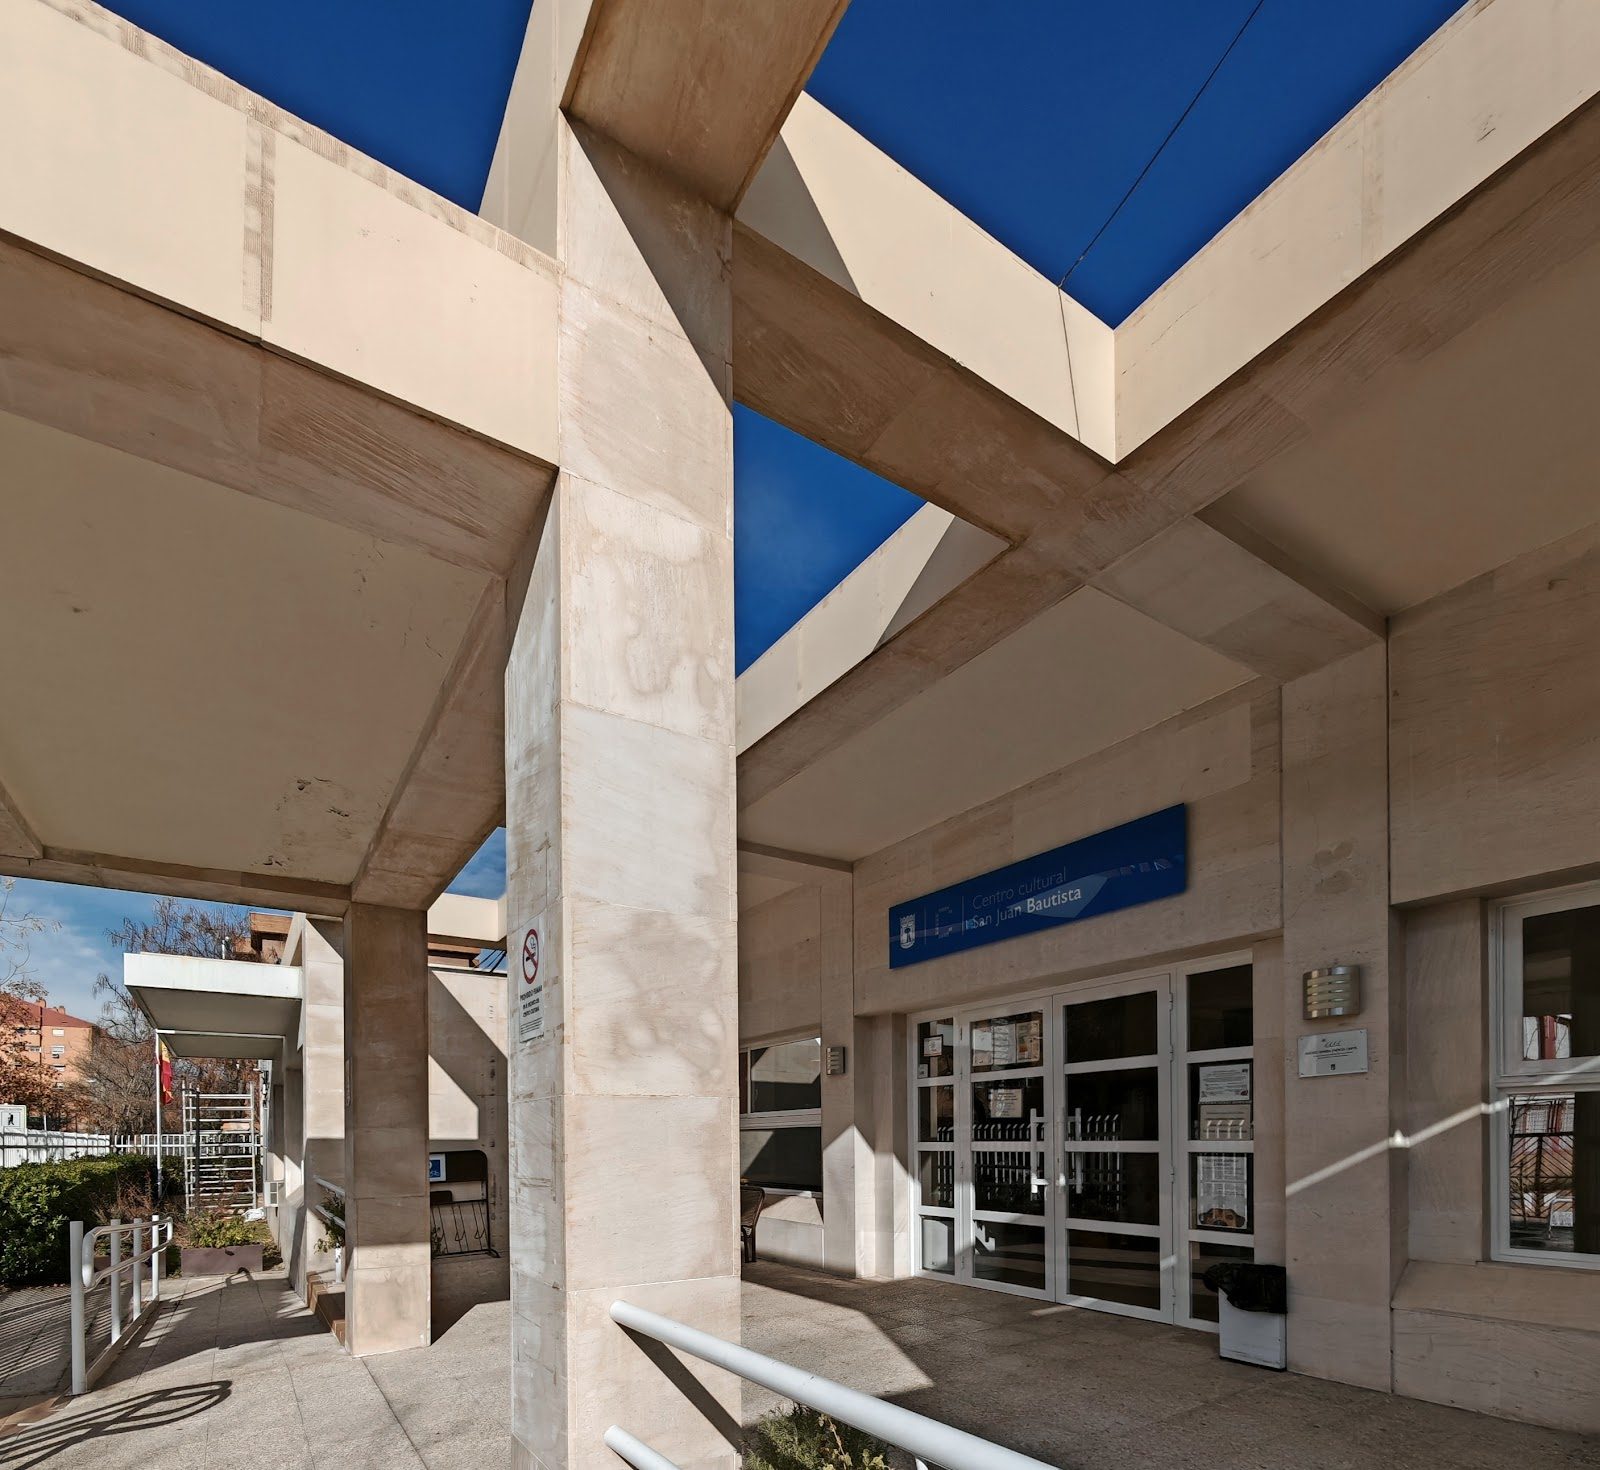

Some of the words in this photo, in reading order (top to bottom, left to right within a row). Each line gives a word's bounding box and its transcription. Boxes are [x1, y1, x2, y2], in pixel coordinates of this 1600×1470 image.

[972, 888, 1014, 910] Centro
[1018, 865, 1066, 896] cultural
[973, 914, 992, 929] San
[995, 905, 1022, 927] Juan
[1026, 888, 1082, 914] Bautista
